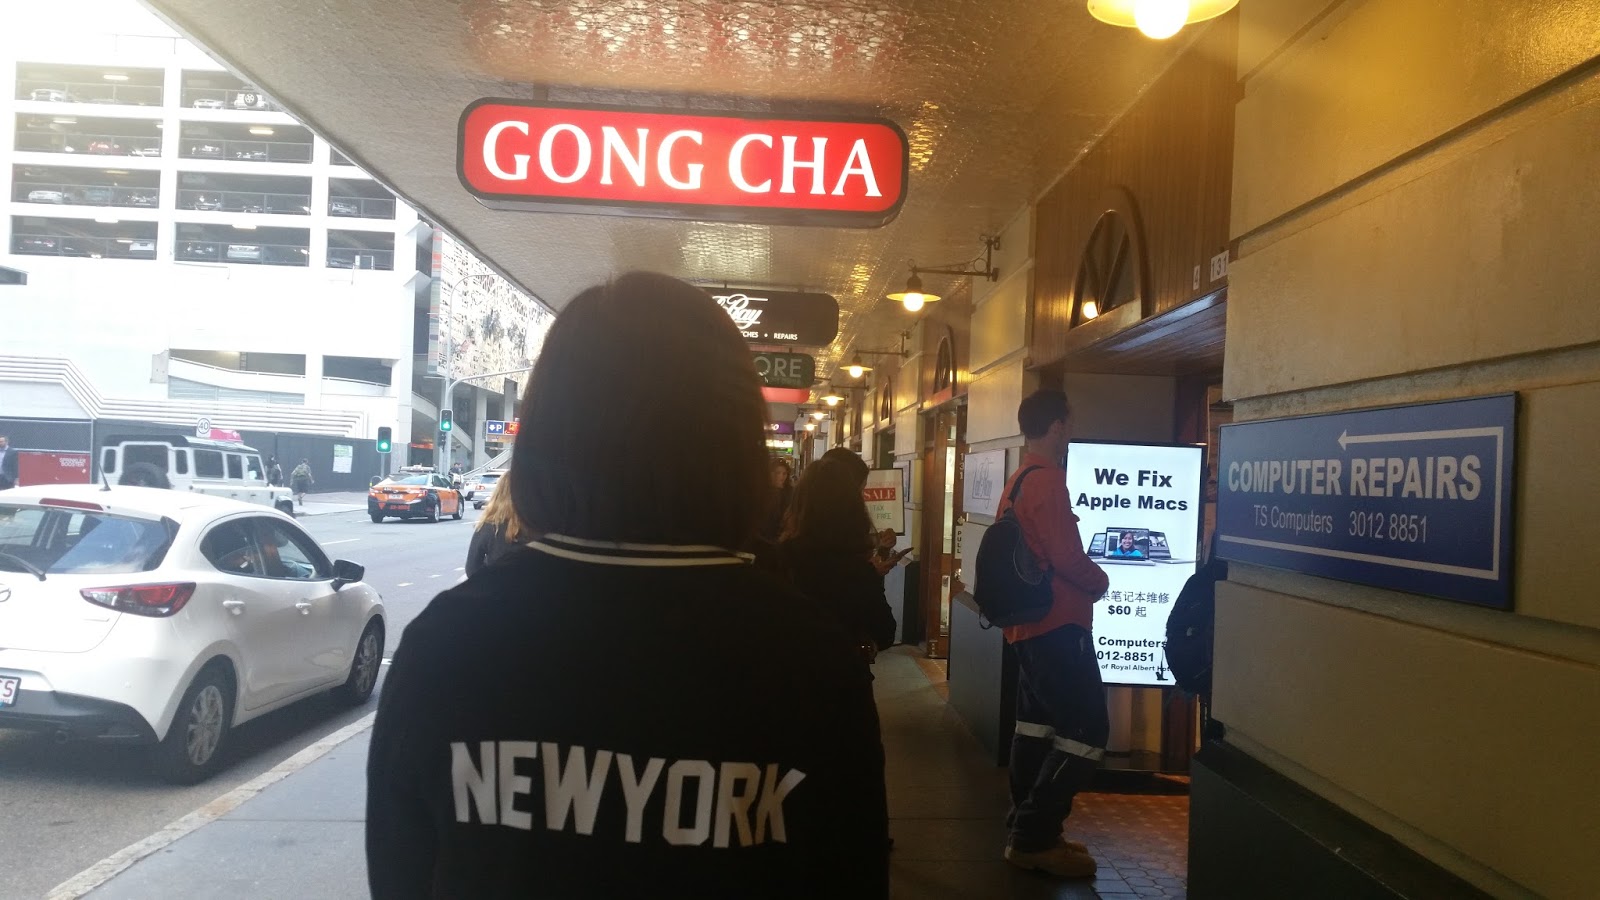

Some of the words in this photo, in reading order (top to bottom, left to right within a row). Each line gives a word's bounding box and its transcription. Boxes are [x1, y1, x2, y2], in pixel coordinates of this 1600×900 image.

[483, 120, 704, 190] GONG
[728, 133, 882, 197] CHA
[1212, 255, 1227, 279] 131
[773, 332, 798, 341] REPAIRS
[199, 421, 209, 431] 40
[496, 424, 502, 432] P
[1094, 468, 1129, 486] We
[1137, 470, 1173, 488] Fix
[1228, 459, 1342, 496] COMPUTER
[1350, 455, 1481, 500] REPAIRS
[864, 489, 896, 500] SALE
[1076, 493, 1131, 511] Apple
[1137, 495, 1188, 511] Macs
[1253, 504, 1268, 528] TS
[1271, 505, 1333, 536] Computers
[1349, 511, 1383, 539] 3012
[1389, 513, 1427, 543] 8851
[1108, 605, 1131, 616] $60
[1134, 606, 1147, 618] 起
[1098, 636, 1167, 649] Computers
